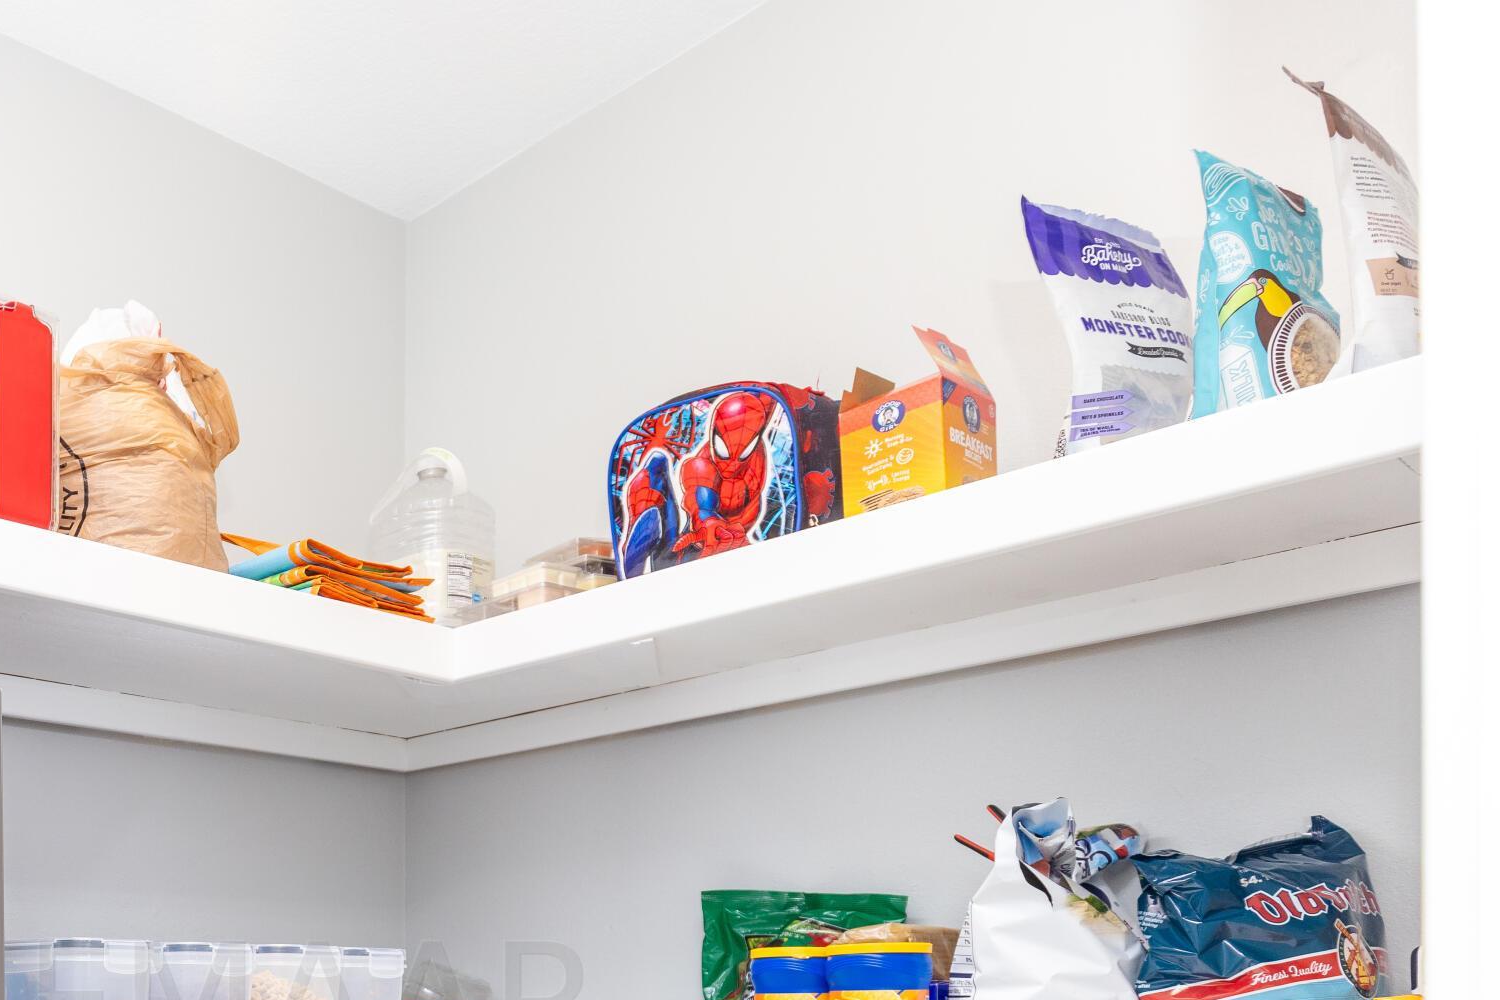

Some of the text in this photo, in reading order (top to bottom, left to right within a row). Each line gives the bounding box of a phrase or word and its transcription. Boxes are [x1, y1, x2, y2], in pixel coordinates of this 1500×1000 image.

[1081, 242, 1141, 271] Bakery
[1081, 317, 1157, 340] MONSTER
[949, 426, 993, 461] BREAKFAST
[59, 486, 78, 534] LITY
[1250, 960, 1333, 987] Finest Quality
